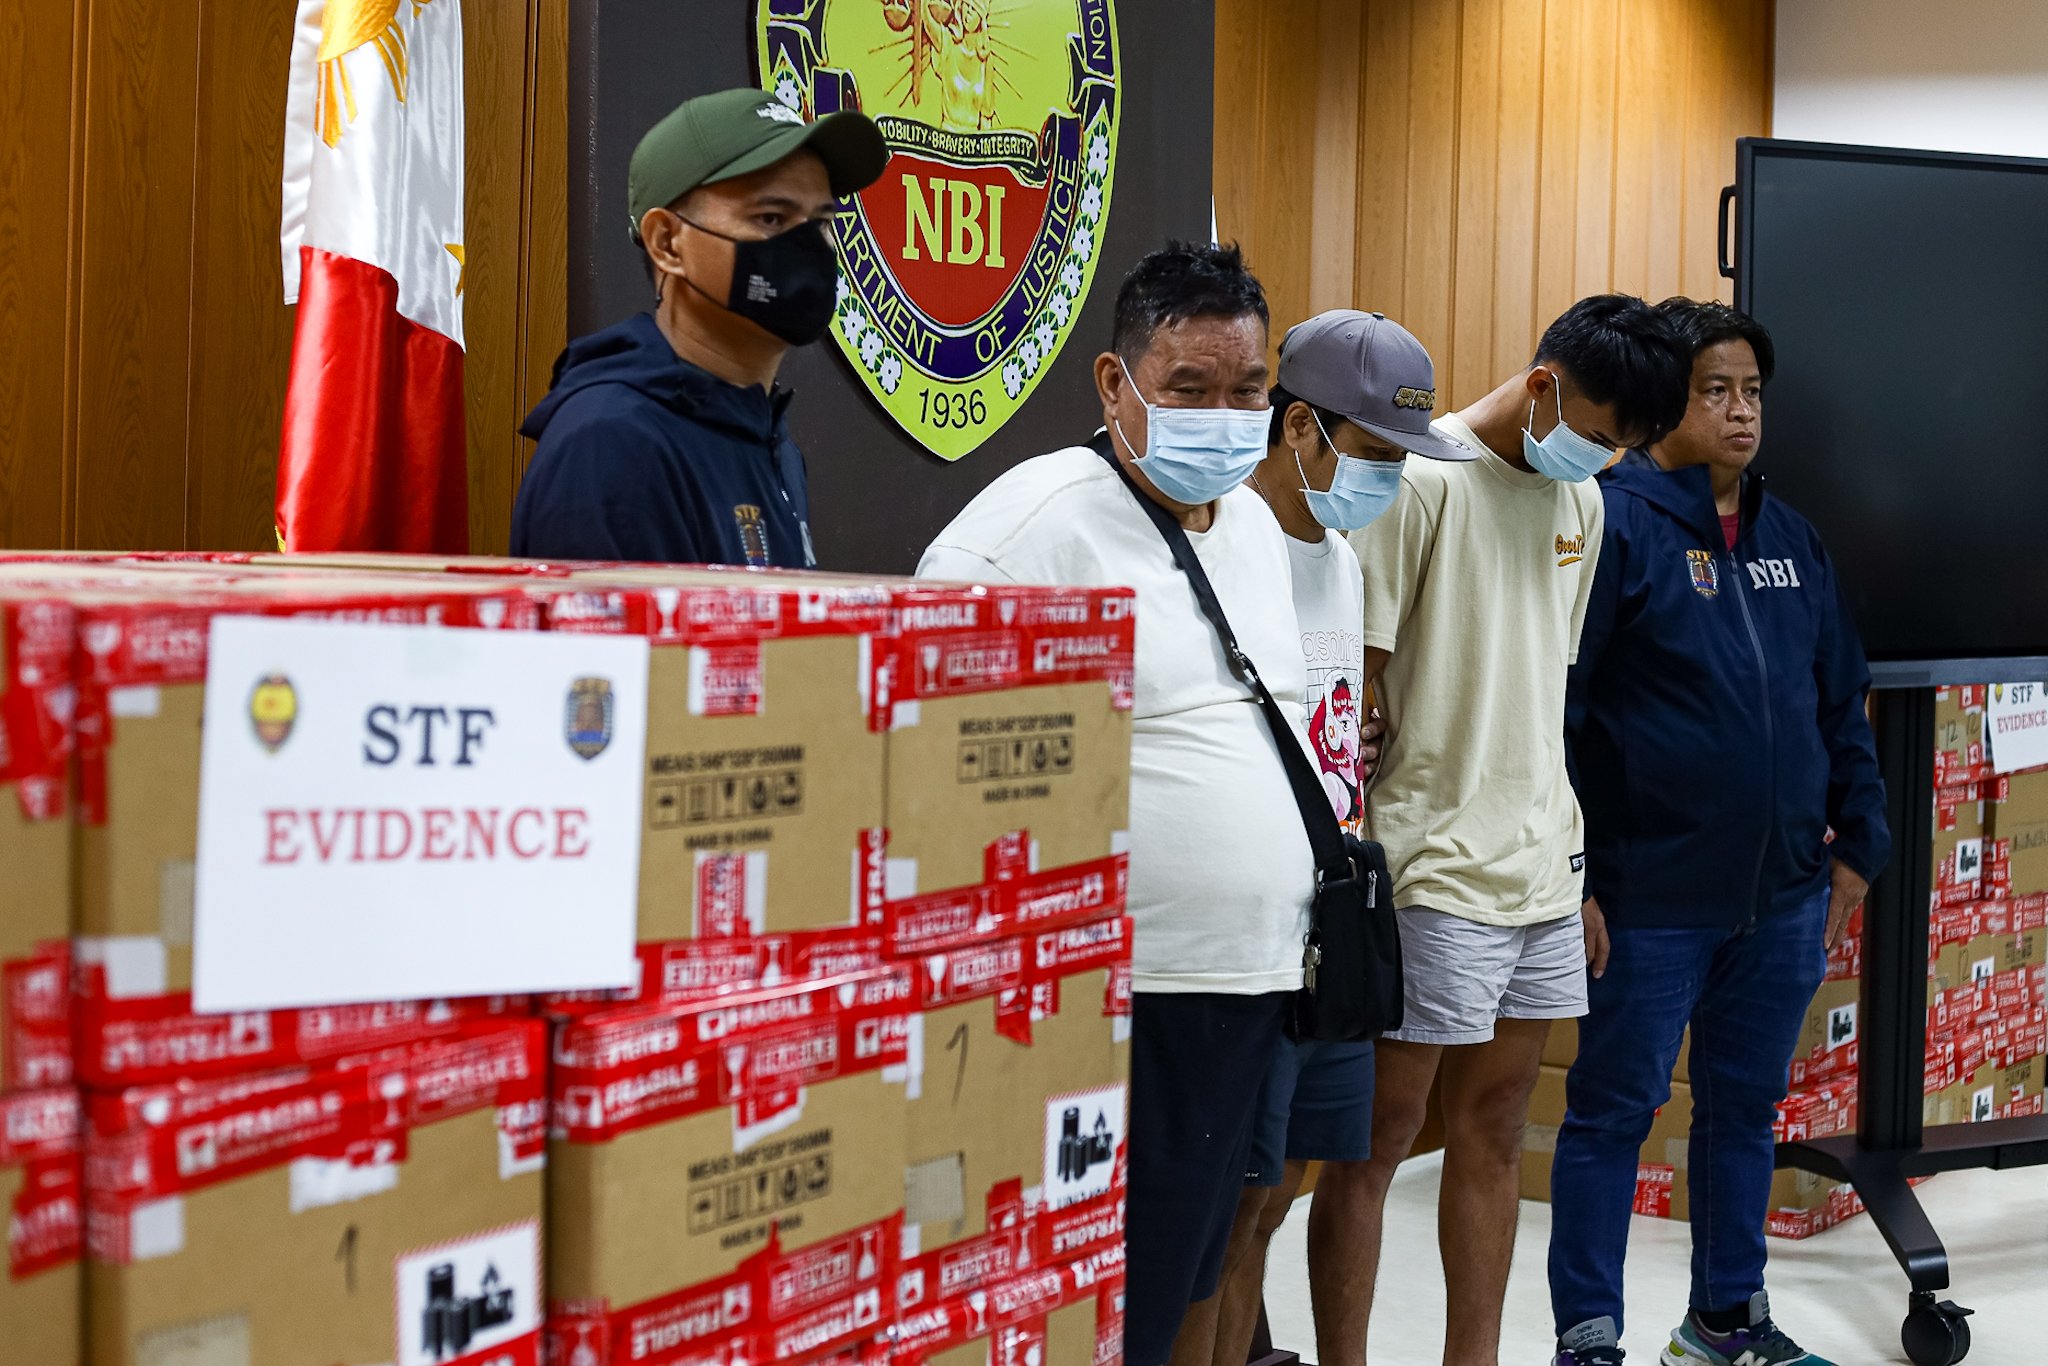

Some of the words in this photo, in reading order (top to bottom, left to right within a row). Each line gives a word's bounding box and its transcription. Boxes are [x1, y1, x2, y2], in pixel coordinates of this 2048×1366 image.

[1088, 0, 1106, 60] ION
[901, 173, 1006, 268] NBI
[834, 196, 942, 366] ARTMENT
[975, 313, 1007, 363] OF
[1022, 157, 1077, 317] JUSTICE
[919, 387, 987, 429] 1936
[1686, 549, 1712, 561] STF
[1746, 558, 1801, 590] NBI
[902, 603, 978, 630] FRAGILE
[2012, 685, 2034, 704] STF
[363, 705, 496, 767] STF
[1997, 710, 2048, 734] EVIDENCE
[260, 807, 592, 866] EVIDENCE
